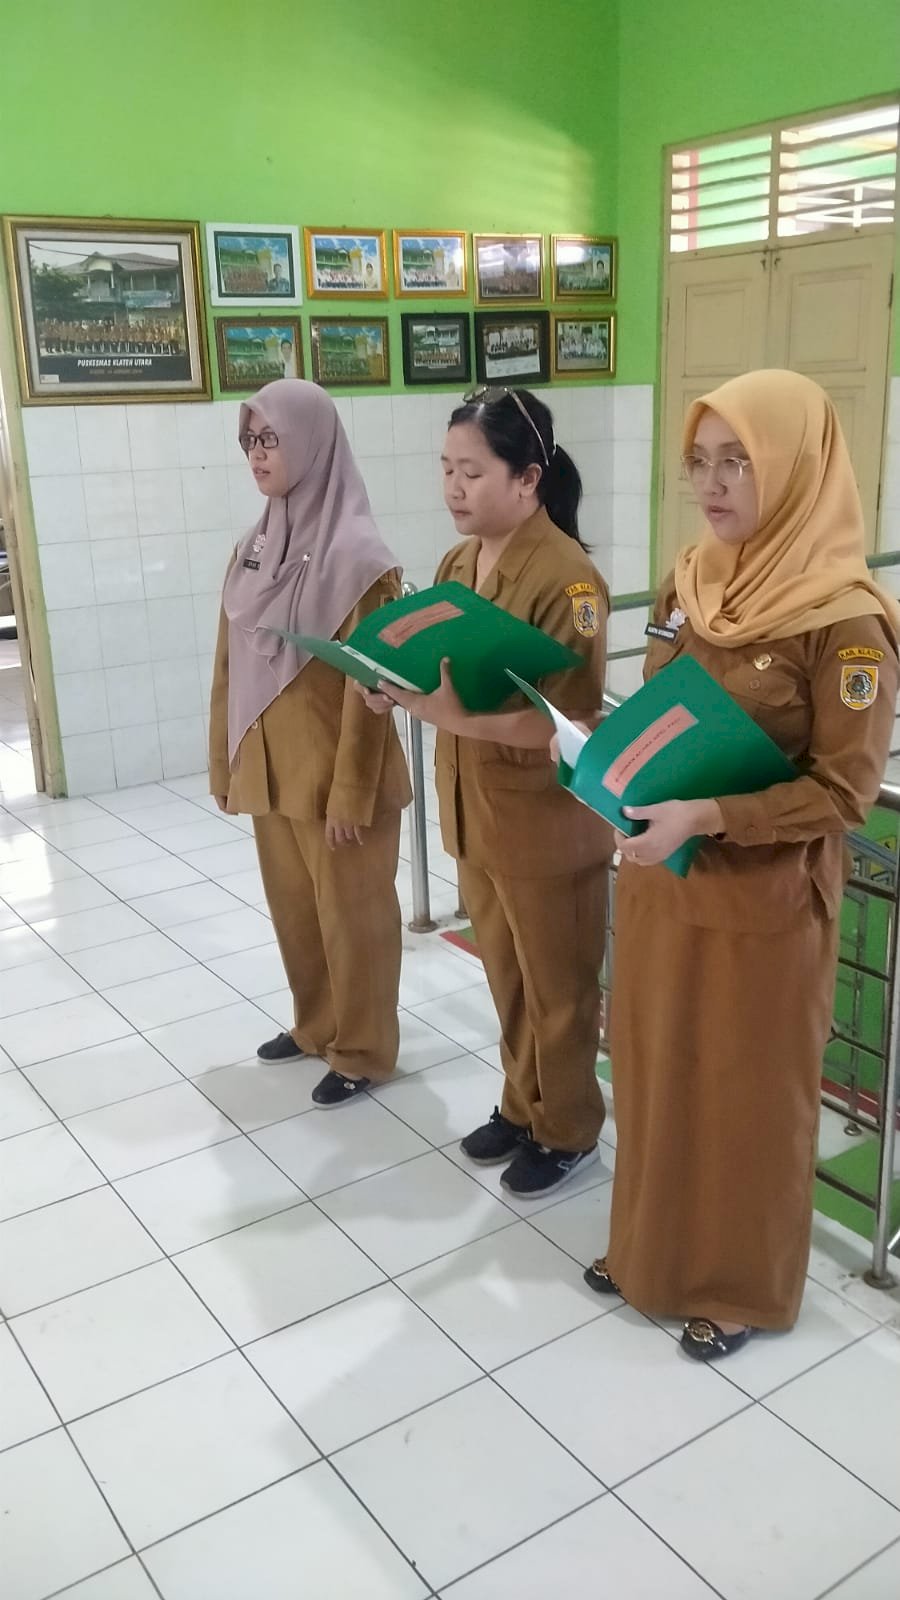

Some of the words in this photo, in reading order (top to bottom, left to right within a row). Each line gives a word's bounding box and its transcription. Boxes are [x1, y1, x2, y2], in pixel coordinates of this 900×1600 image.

[77, 359, 111, 368] PUSKESMAS
[112, 358, 134, 367] KLATEN
[134, 358, 153, 367] UTARA
